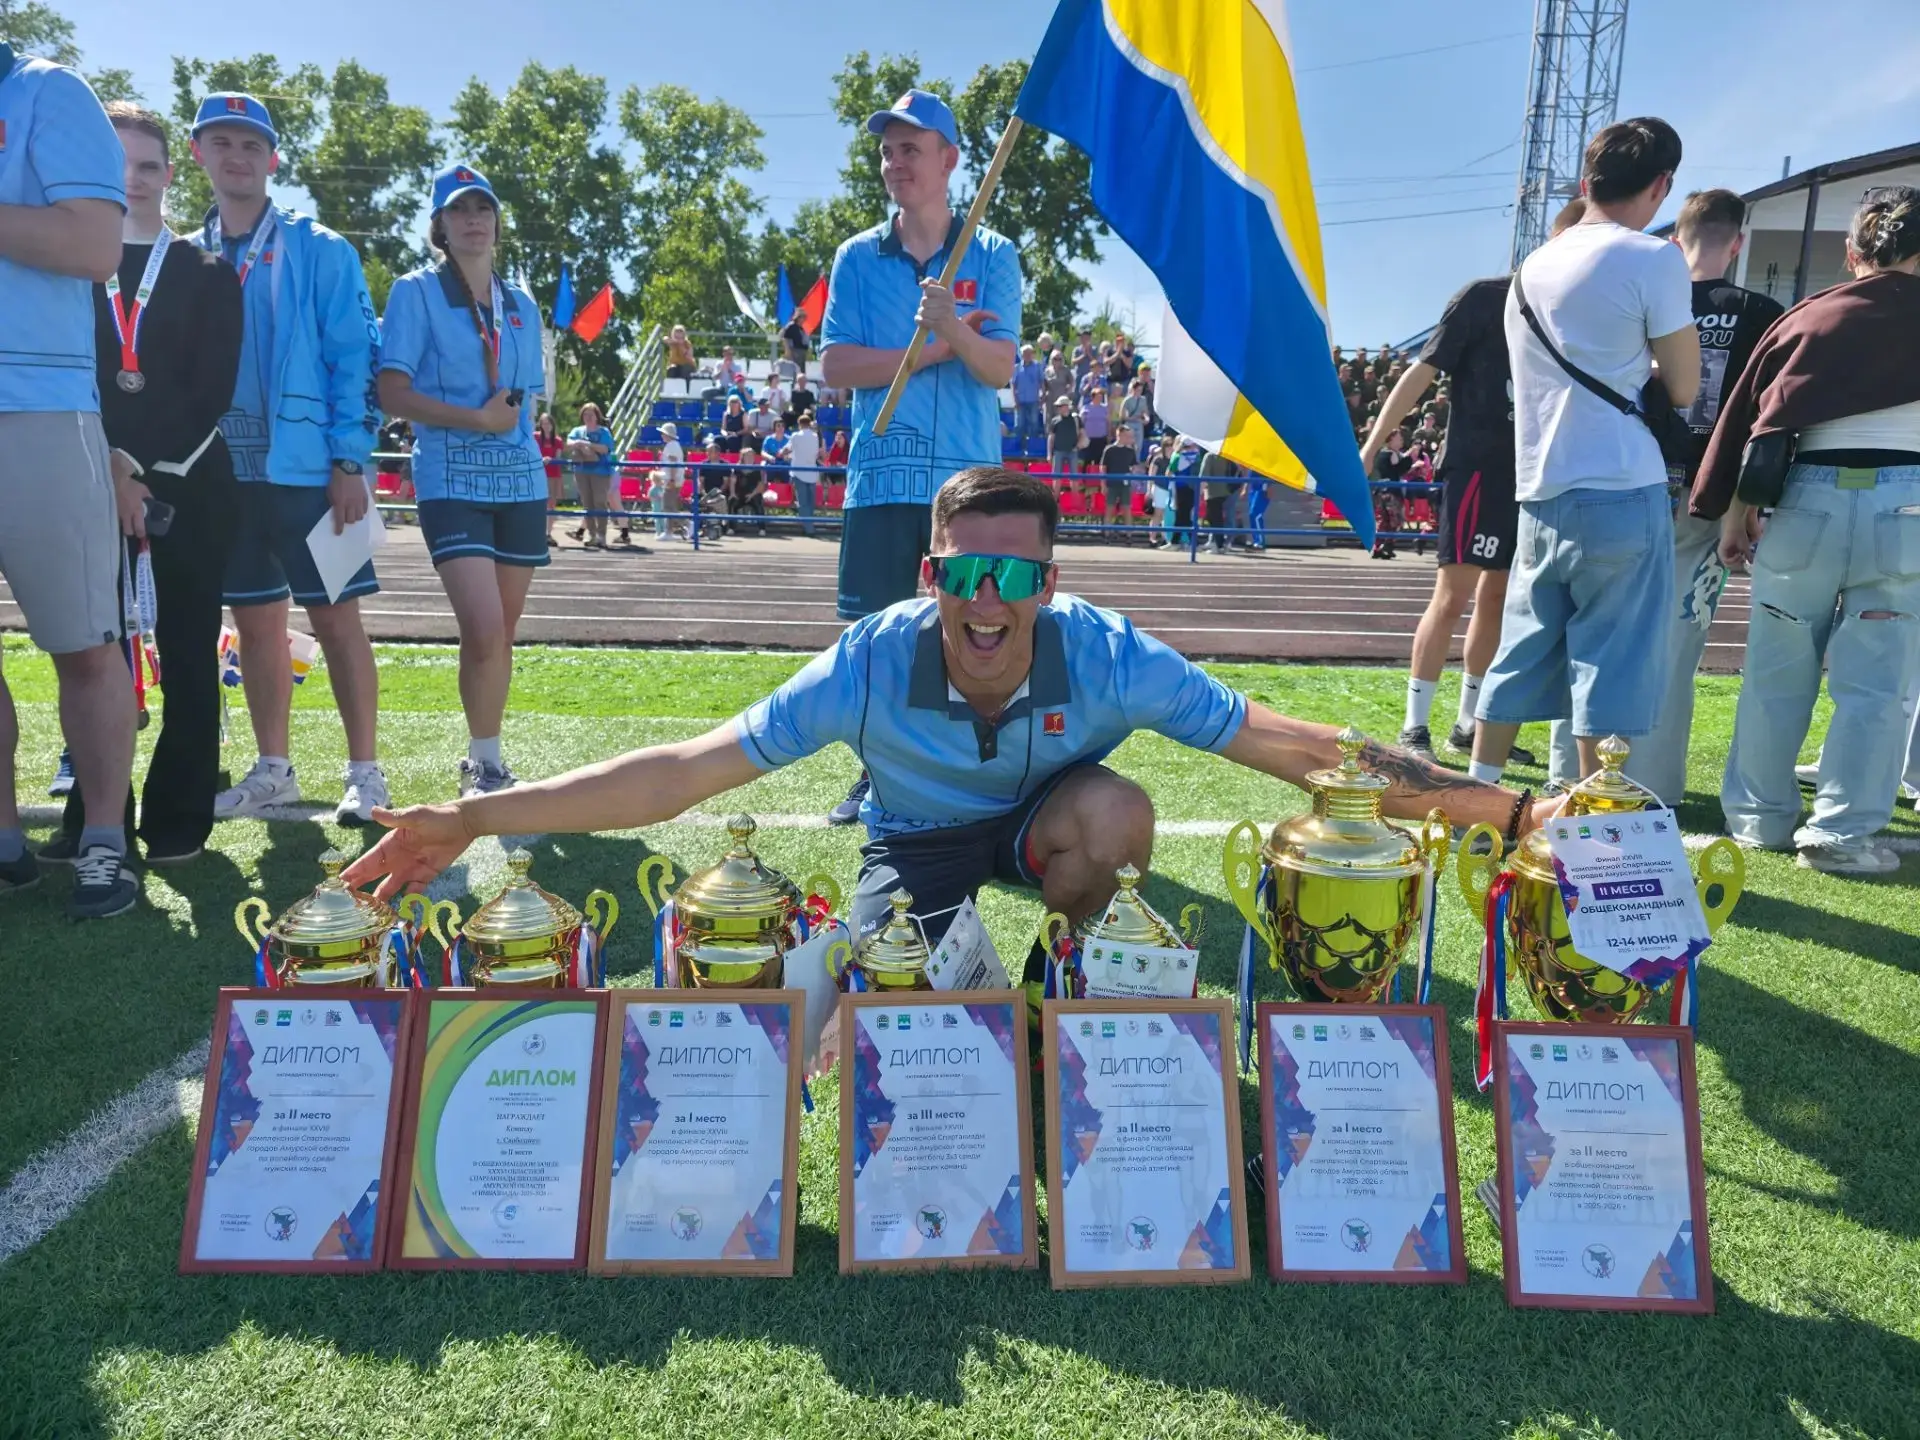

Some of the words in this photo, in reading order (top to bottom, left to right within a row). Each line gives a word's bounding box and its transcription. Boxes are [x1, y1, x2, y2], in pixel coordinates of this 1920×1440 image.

[1699, 331, 1734, 346] OU
[1472, 534, 1500, 559] 28
[1595, 855, 1620, 863] Финал
[1599, 887, 1607, 896] II
[1611, 884, 1655, 895] МЕСТО
[1581, 899, 1685, 914] ОБЩЕКОМАНДНЫЙ
[1619, 913, 1651, 923] ЗАЧЕТ
[1607, 938, 1635, 948] 12-14
[1638, 934, 1678, 945] ИЮНЯ
[262, 1046, 360, 1065] ДИПЛОМ
[658, 1047, 751, 1066] ДИПЛОМ
[890, 1047, 980, 1068] ДИПЛОМ
[1100, 1057, 1182, 1077] ДИПЛОМ
[1308, 1060, 1399, 1079] ДИПЛОМ
[485, 1069, 576, 1086] ДИПЛОМ
[1547, 1081, 1644, 1101] ДИПЛОМ
[289, 1109, 297, 1119] II
[695, 1115, 726, 1123] место
[921, 1110, 932, 1119] III
[1131, 1123, 1138, 1132] II
[1141, 1125, 1171, 1133] место
[1584, 1146, 1592, 1156] II
[1596, 1149, 1627, 1157] место
